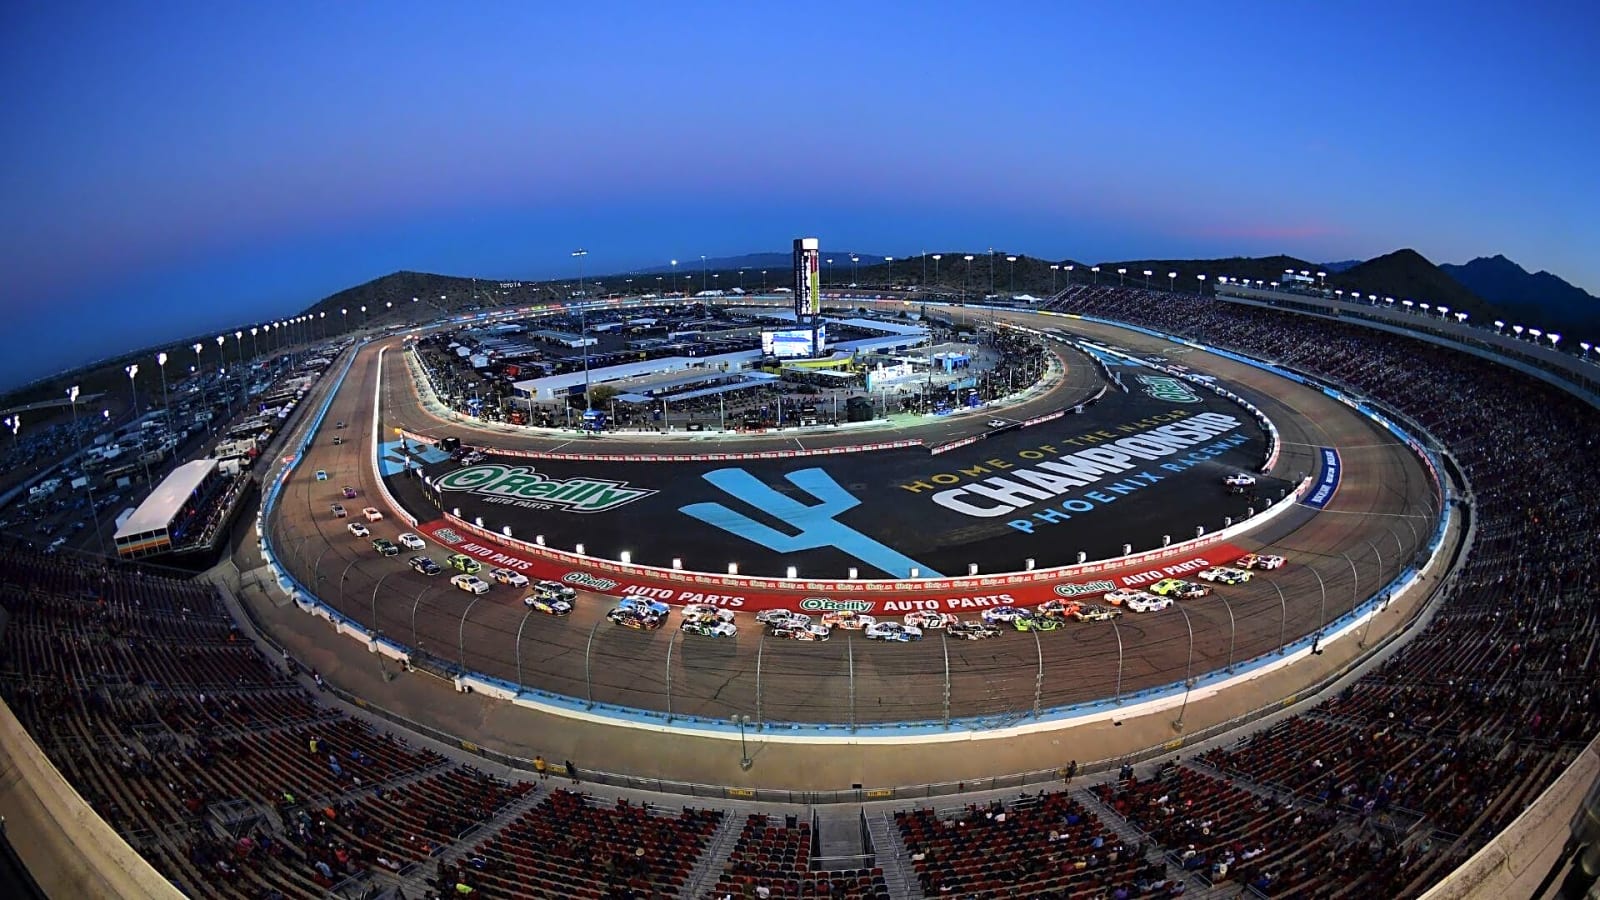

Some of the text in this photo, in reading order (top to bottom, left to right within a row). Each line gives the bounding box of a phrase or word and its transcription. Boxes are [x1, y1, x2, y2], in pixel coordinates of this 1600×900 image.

[901, 409, 1191, 494] HOME OF THE NASCAR
[931, 411, 1243, 518] CHAMPIONSHIP
[438, 464, 648, 510] O'Reilly
[482, 496, 554, 511] AUTO PARTS
[1007, 433, 1250, 534] PHOENIX RACEWAY
[460, 543, 495, 561] AUTO
[490, 552, 534, 571] PARTS
[1053, 579, 1118, 597] O'Reilly
[1121, 570, 1164, 587] AUTO
[1162, 557, 1211, 576] PARTS
[562, 571, 745, 608] O'Reilly AUTO PARTS
[799, 594, 1015, 613] O'Reilly AUTO PARTS
